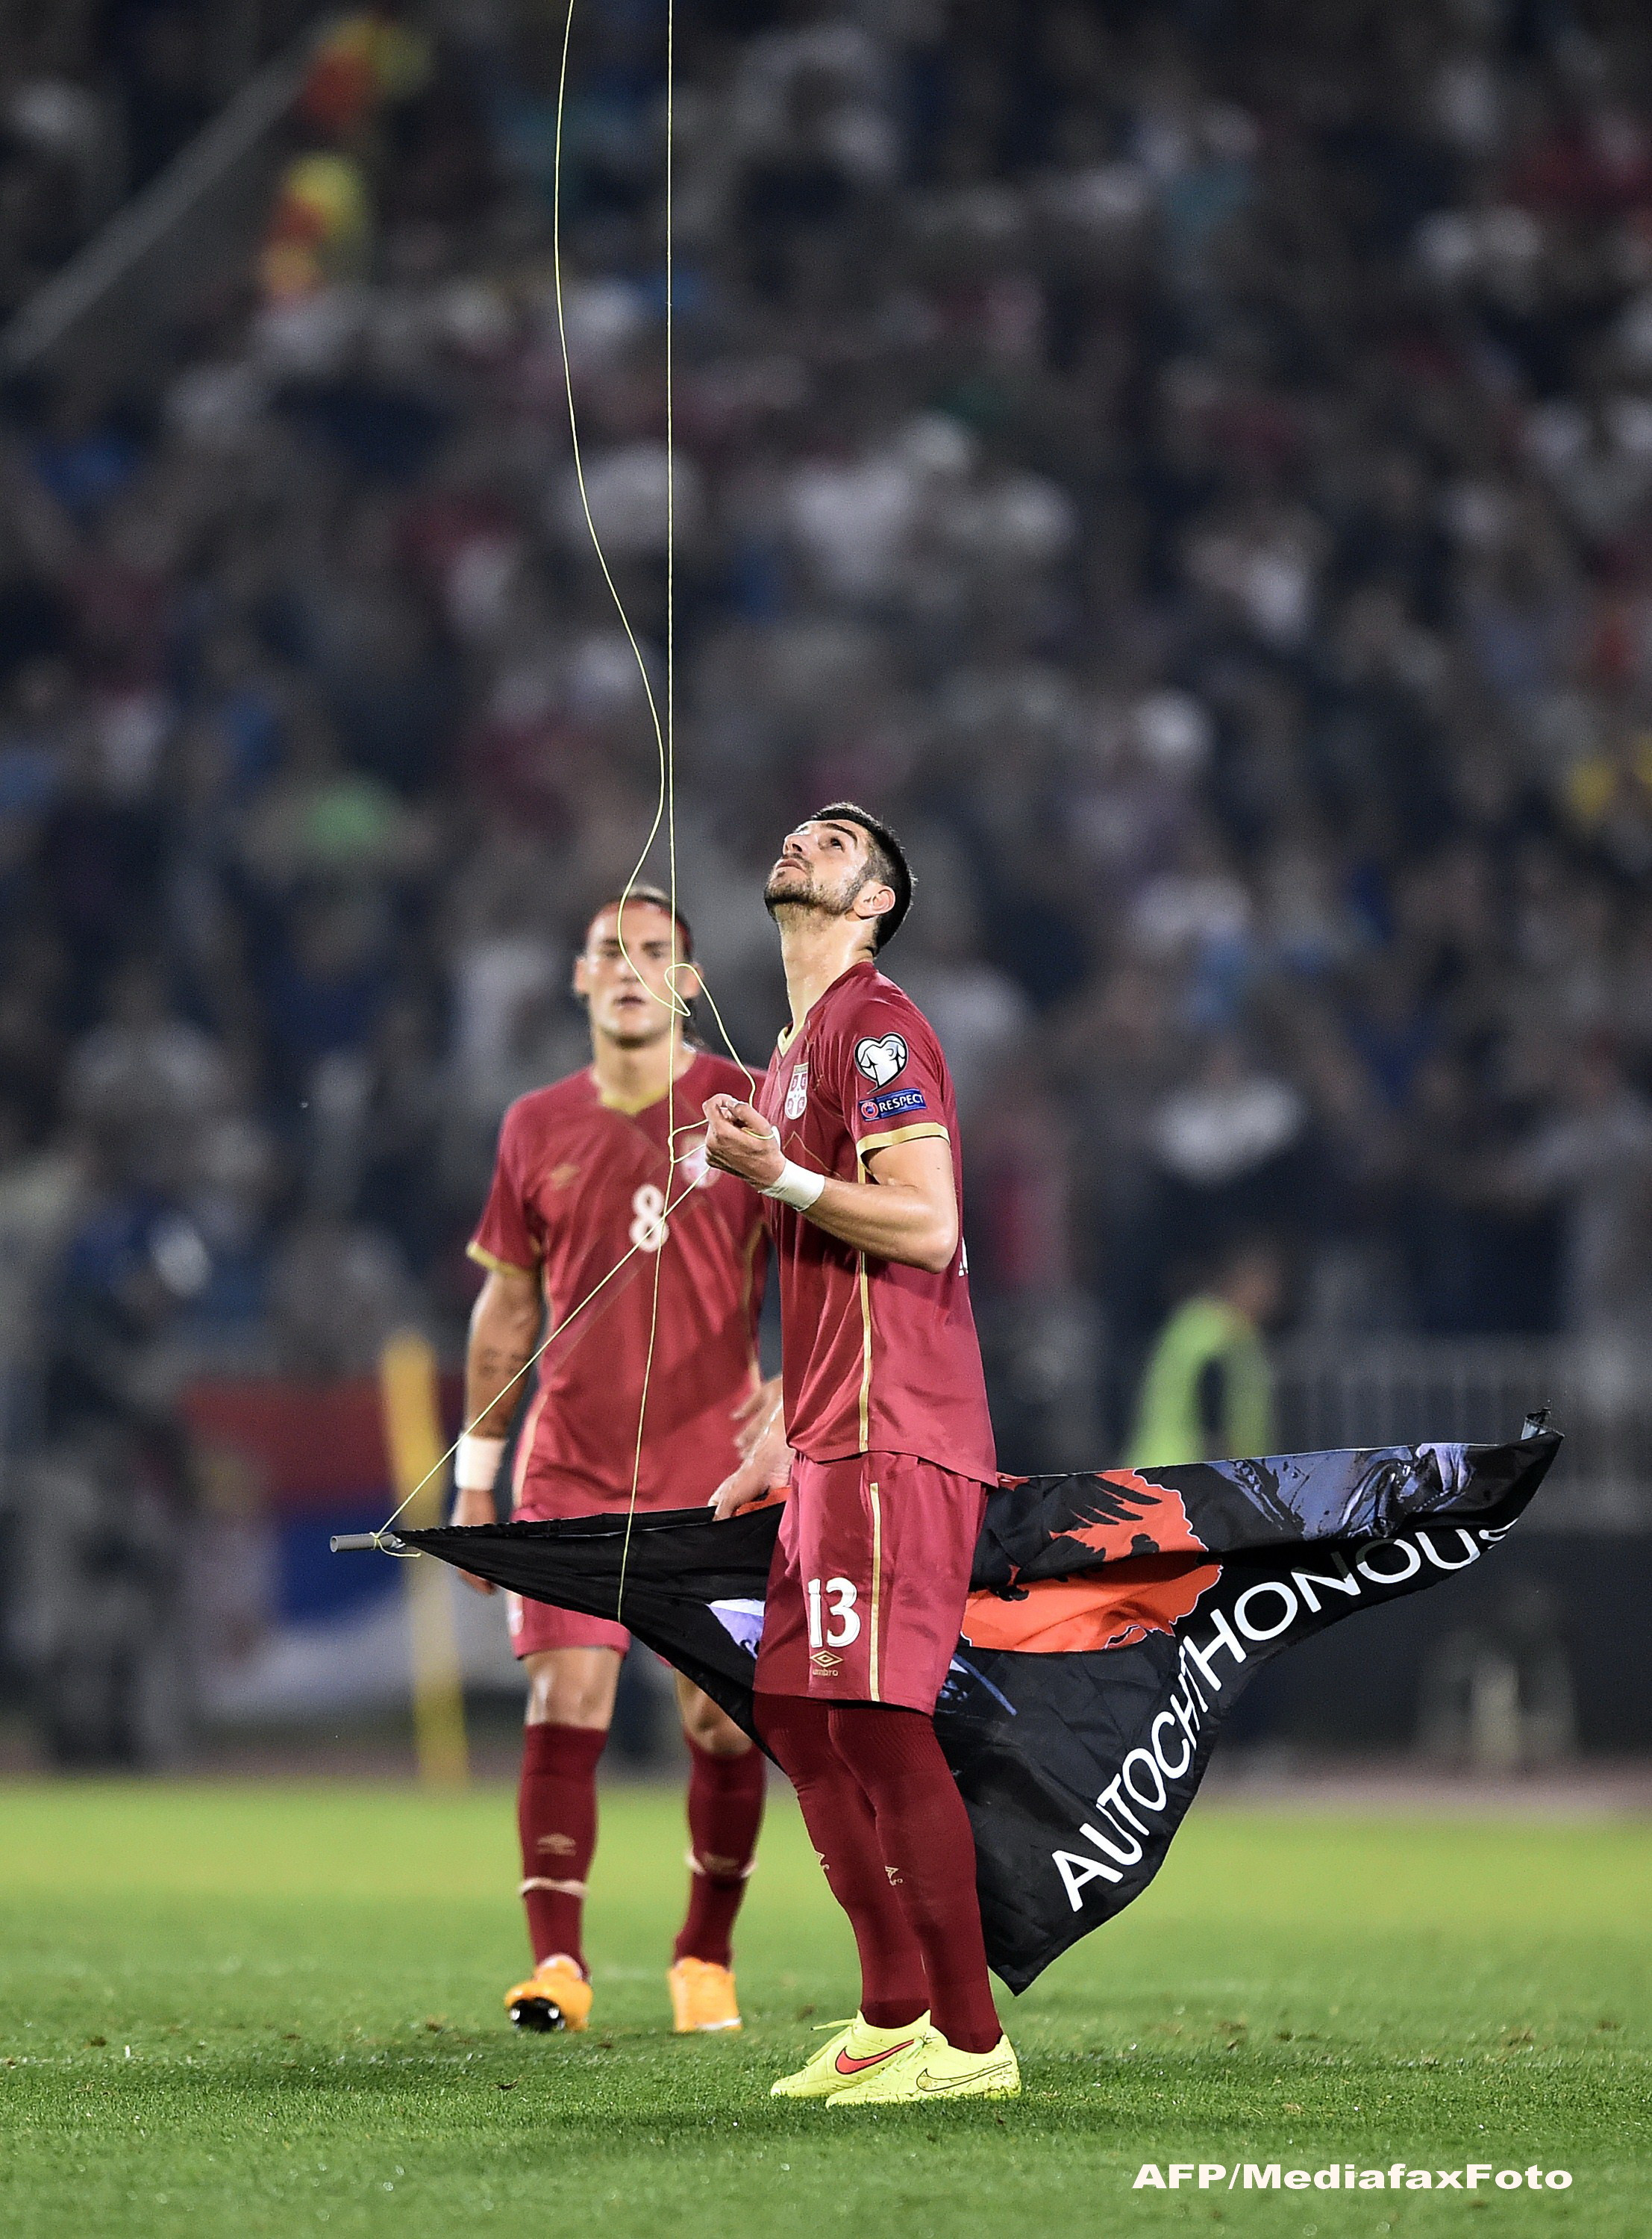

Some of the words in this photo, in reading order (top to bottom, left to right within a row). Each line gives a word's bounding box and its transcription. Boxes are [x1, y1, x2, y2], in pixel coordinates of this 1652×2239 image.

[879, 1093, 923, 1112] RESPECT
[628, 1184, 669, 1253] 8
[808, 1577, 860, 1648] 13
